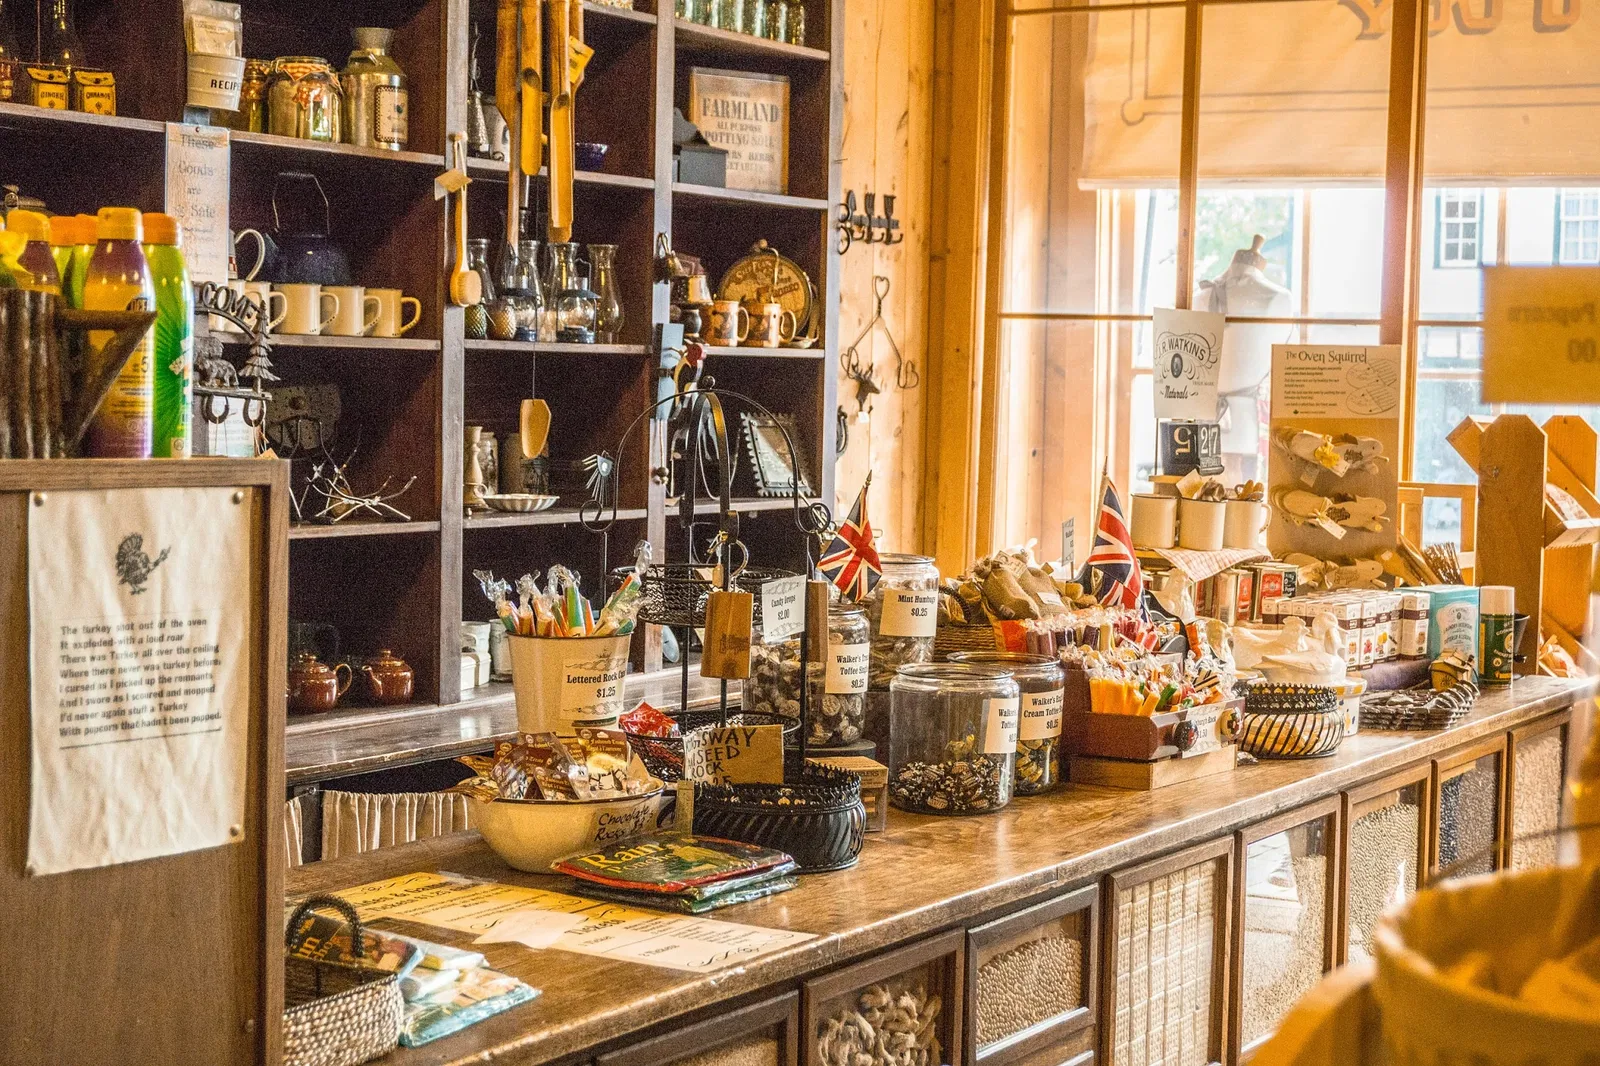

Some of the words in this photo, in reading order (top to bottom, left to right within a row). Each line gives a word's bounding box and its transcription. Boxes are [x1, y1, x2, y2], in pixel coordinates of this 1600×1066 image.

[702, 97, 779, 123] FARMLAND
[180, 134, 215, 150] These
[704, 131, 749, 146] POTTING
[178, 160, 215, 178] Goods
[202, 281, 263, 322] COME
[1168, 337, 1206, 362] WATKINS
[1285, 351, 1297, 360] The
[1298, 350, 1325, 363] Oven
[1328, 348, 1367, 364] Squirrel
[1163, 385, 1189, 399] Naturals
[898, 594, 914, 603] Mint
[911, 607, 928, 617] $0.25
[60, 625, 78, 635] The
[139, 620, 153, 630] out
[171, 619, 183, 628] the
[146, 634, 164, 643] loud
[60, 654, 87, 664] There
[89, 654, 106, 662] was
[142, 648, 152, 658] all
[155, 648, 173, 656] over
[176, 646, 190, 654] the
[193, 643, 219, 653] ceiling
[836, 654, 862, 663] Walker's
[92, 667, 115, 676] there
[118, 665, 140, 674] never
[163, 660, 190, 670] turkey
[840, 666, 858, 675] Toffee
[64, 682, 95, 693] cursed
[115, 678, 143, 691] picked
[145, 677, 155, 687] up
[158, 675, 172, 684] the
[567, 674, 602, 684] Lettered
[603, 672, 617, 682] Rock
[851, 678, 865, 689] $0.25
[59, 697, 77, 708] And
[85, 696, 111, 705] swore
[113, 695, 124, 703] as
[132, 690, 164, 701] scoured
[166, 688, 181, 697] and
[183, 684, 216, 696] mopped
[597, 686, 616, 698] $1.25
[1032, 696, 1056, 706] Walker's
[74, 712, 99, 721] never
[101, 707, 126, 719] again
[158, 702, 188, 712] Turkey
[1023, 709, 1045, 718] Cream
[59, 727, 81, 737] With
[84, 723, 119, 737] popcorn
[121, 721, 140, 731] that
[169, 716, 189, 725] been
[1046, 718, 1059, 729] $0.25
[688, 727, 757, 750] SWAY
[1199, 729, 1208, 739] 1.50
[690, 745, 741, 766] SEED
[692, 761, 725, 779] ROCK
[598, 804, 650, 826] Chocolate
[594, 827, 625, 842] Rocks
[580, 843, 665, 870] Rain
